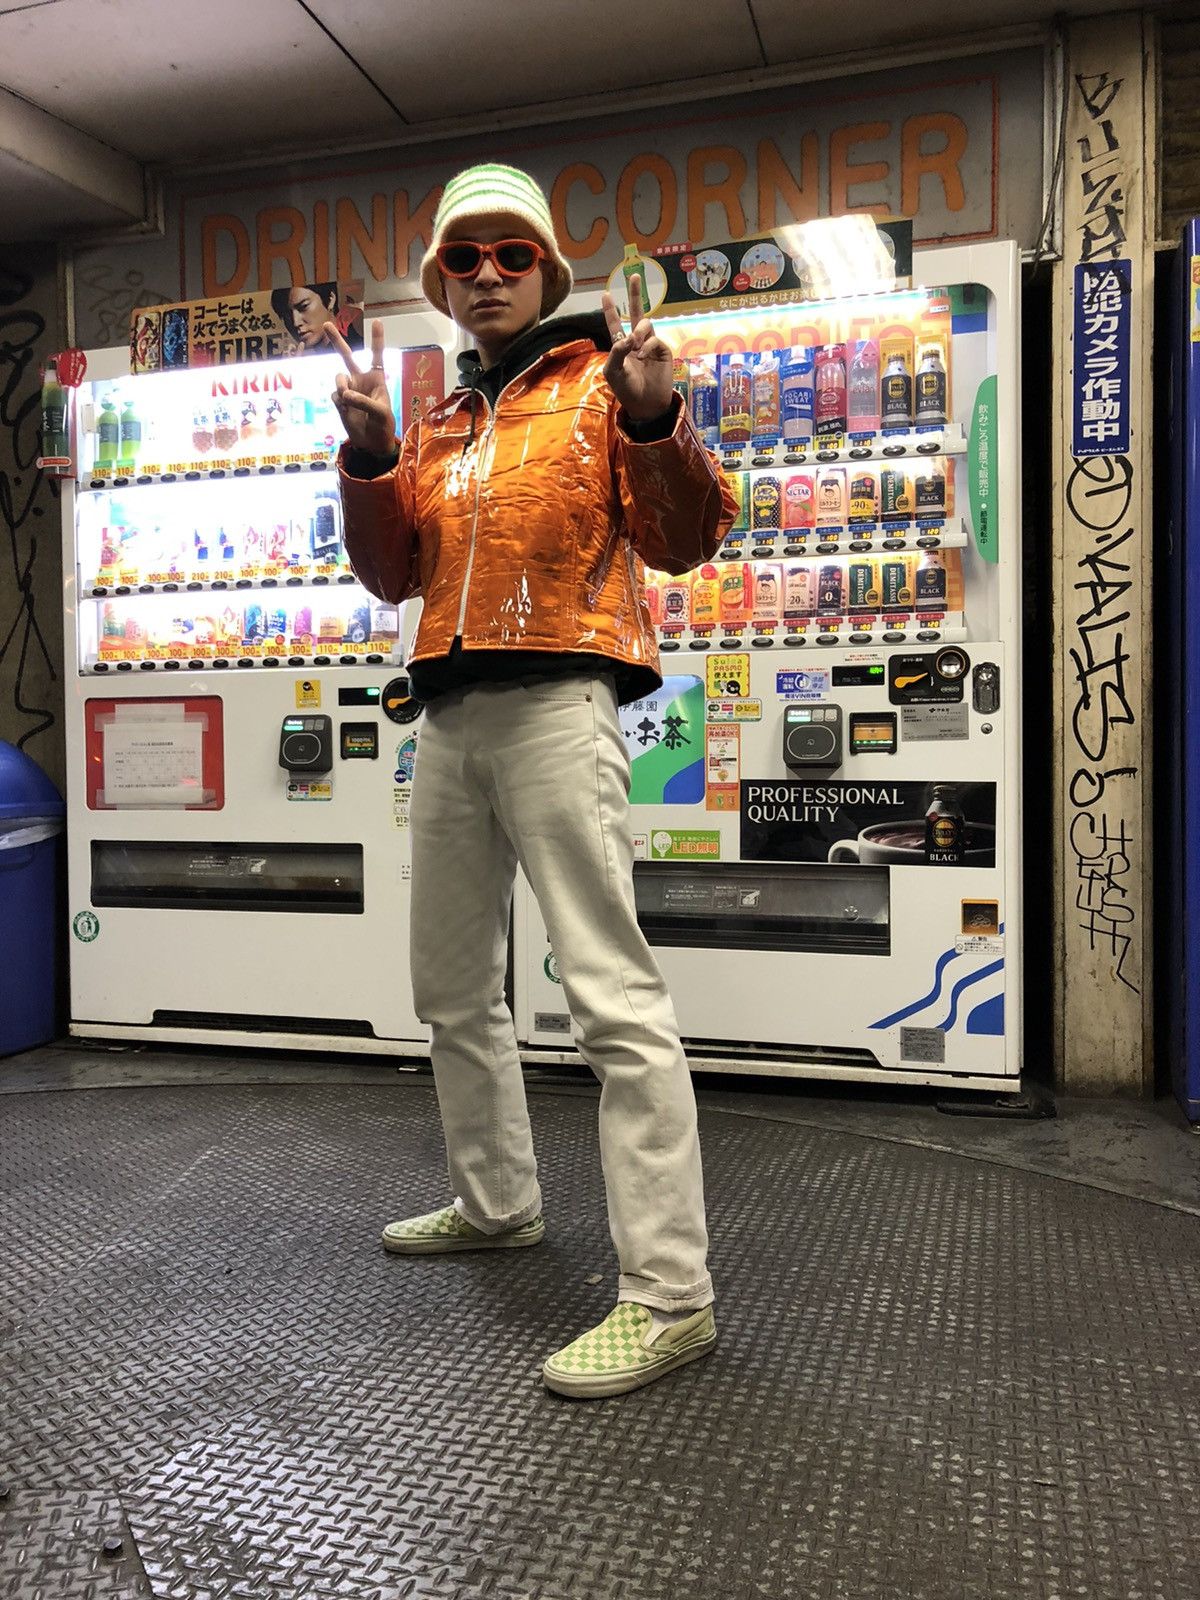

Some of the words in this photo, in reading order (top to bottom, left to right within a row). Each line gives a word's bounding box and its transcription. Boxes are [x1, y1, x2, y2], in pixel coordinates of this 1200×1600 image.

[202, 185, 443, 297] DRINK
[550, 111, 969, 260] CORNER
[194, 297, 254, 319] コーヒーは
[193, 314, 277, 338] 火でうまくなる。
[1081, 271, 1122, 442] 防犯カメラ作動中
[211, 371, 293, 397] KIRIN
[748, 786, 905, 805] PROFESSIONAL
[748, 805, 839, 823] QUALITY
[929, 853, 959, 862] BLACK
